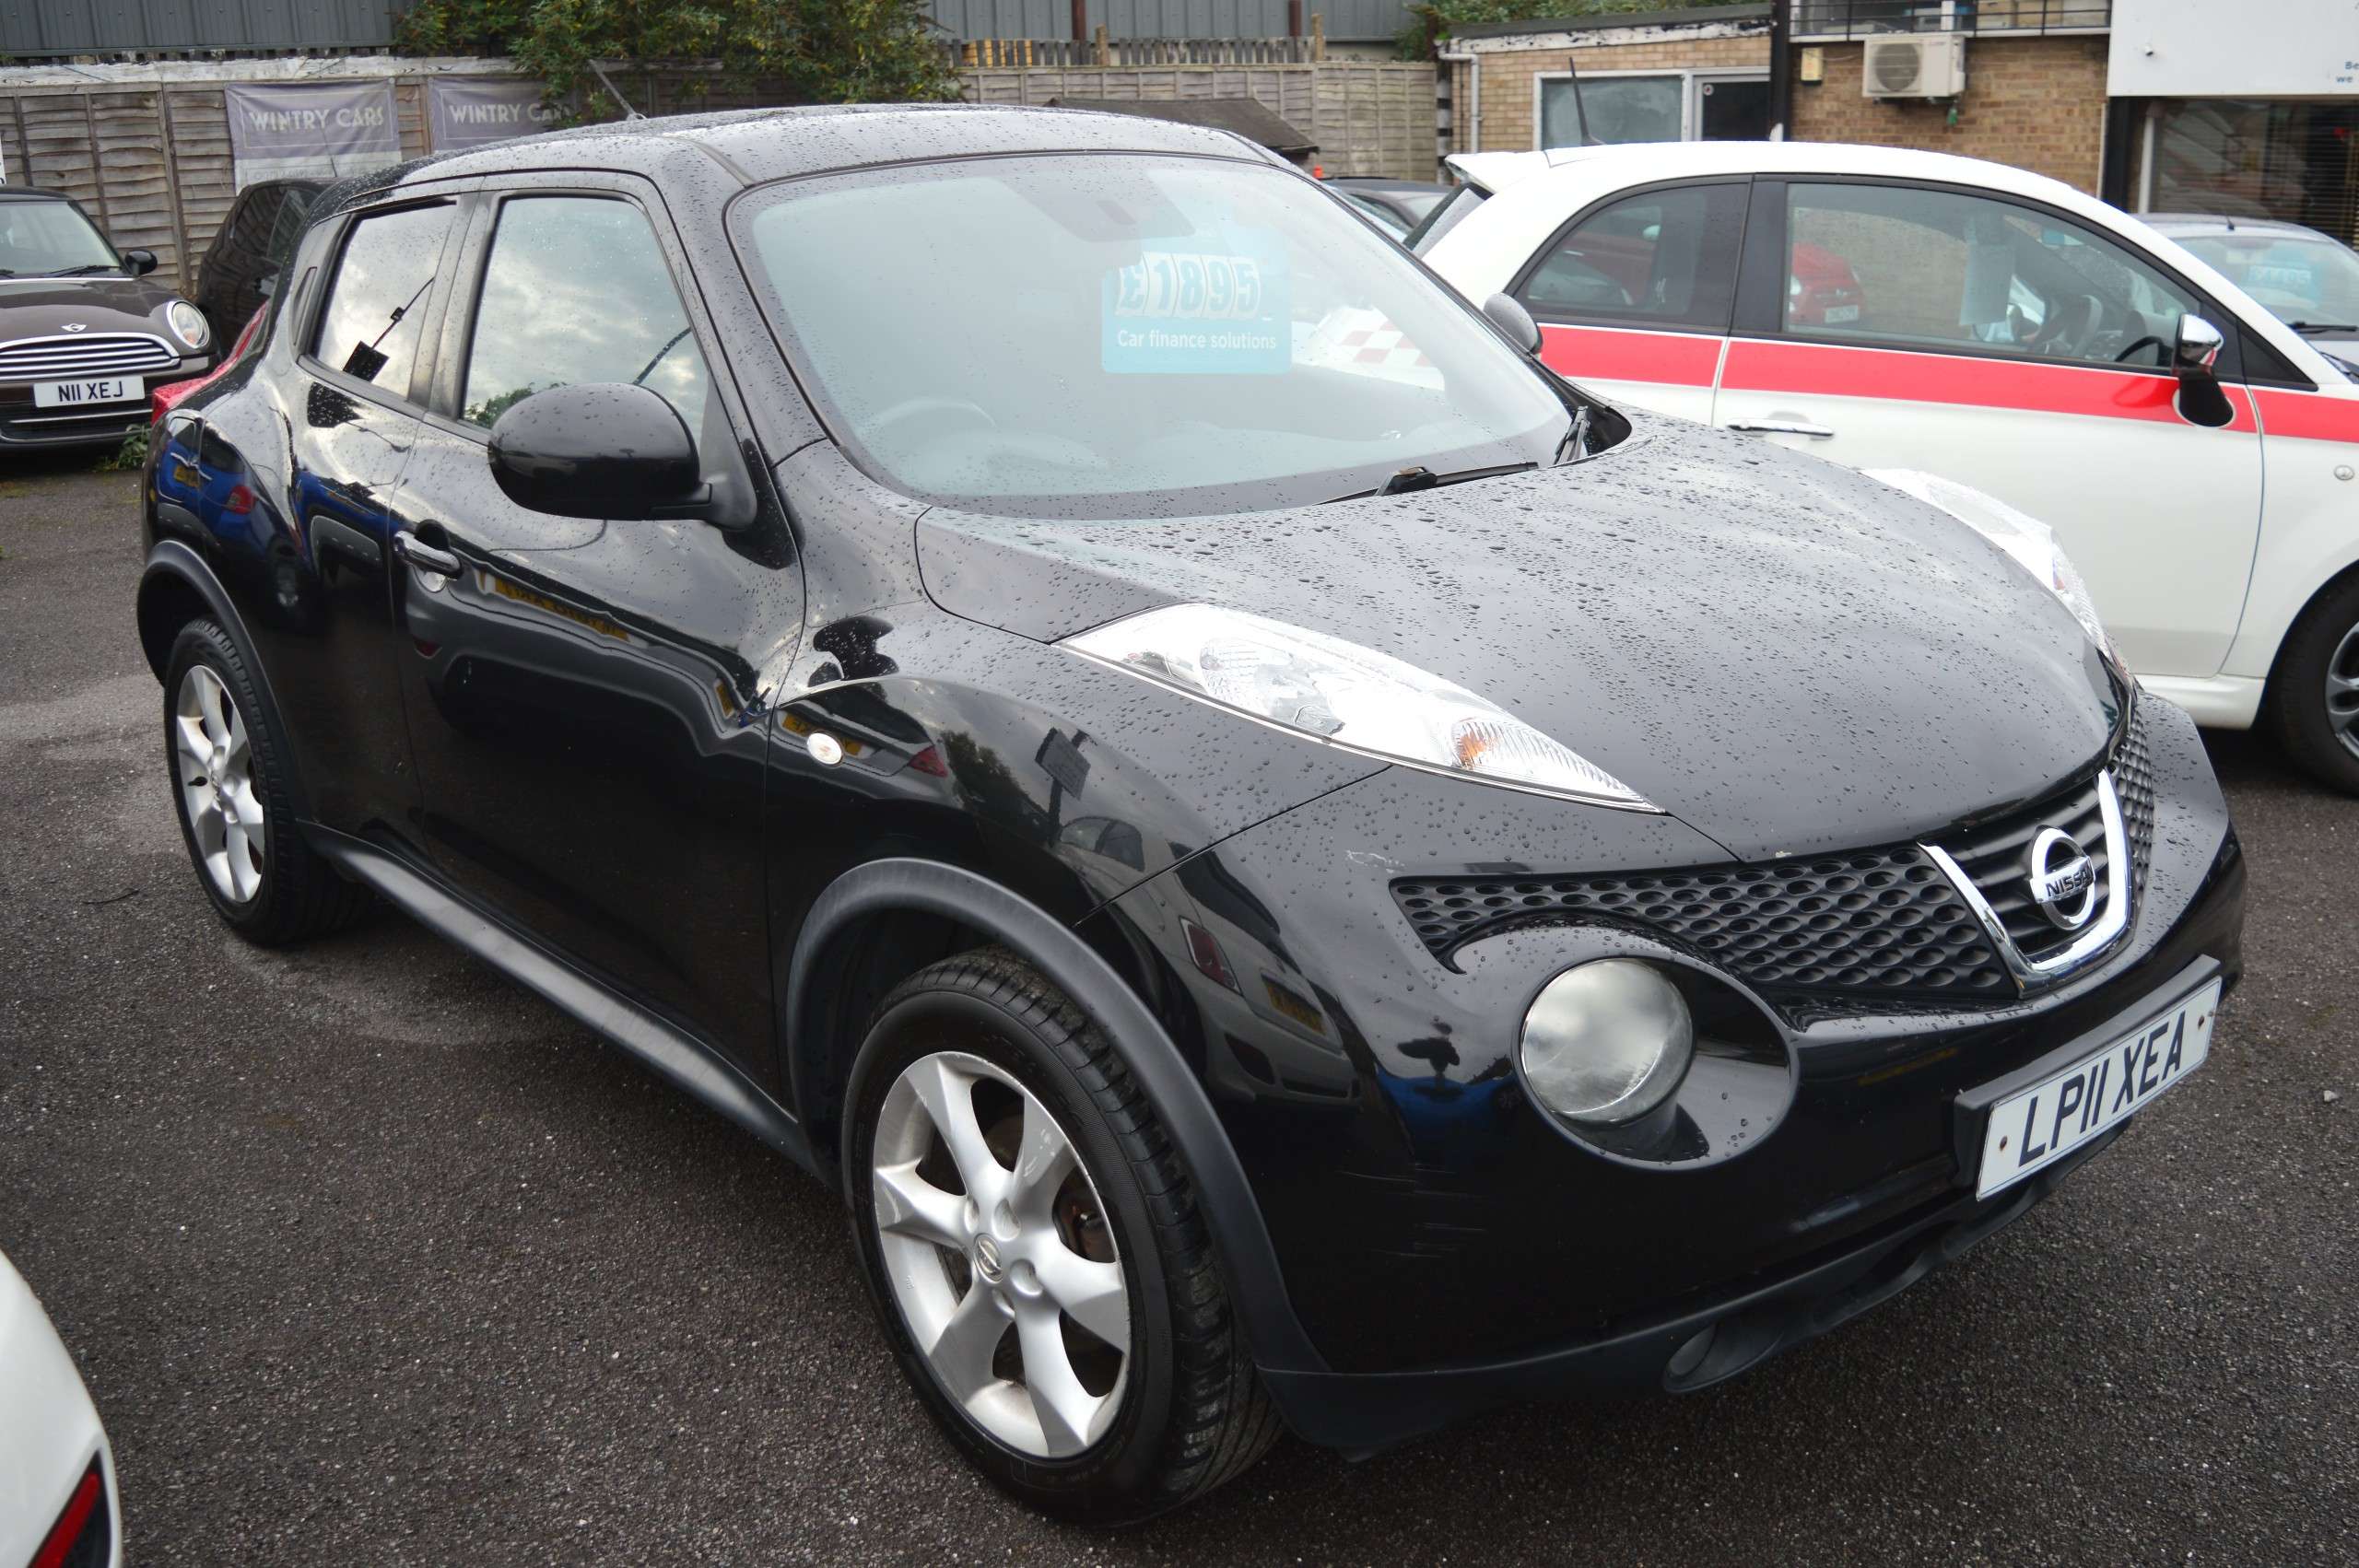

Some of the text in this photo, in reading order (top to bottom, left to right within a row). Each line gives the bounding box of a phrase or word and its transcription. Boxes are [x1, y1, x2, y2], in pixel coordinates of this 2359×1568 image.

[249, 106, 384, 131] WINTRY CARS
[449, 103, 522, 124] WINTRY
[1121, 258, 1258, 313] £1895
[1118, 329, 1276, 350] Car finance solutions
[87, 380, 123, 400] XEJ
[2018, 1010, 2187, 1168] LP11 XEA
